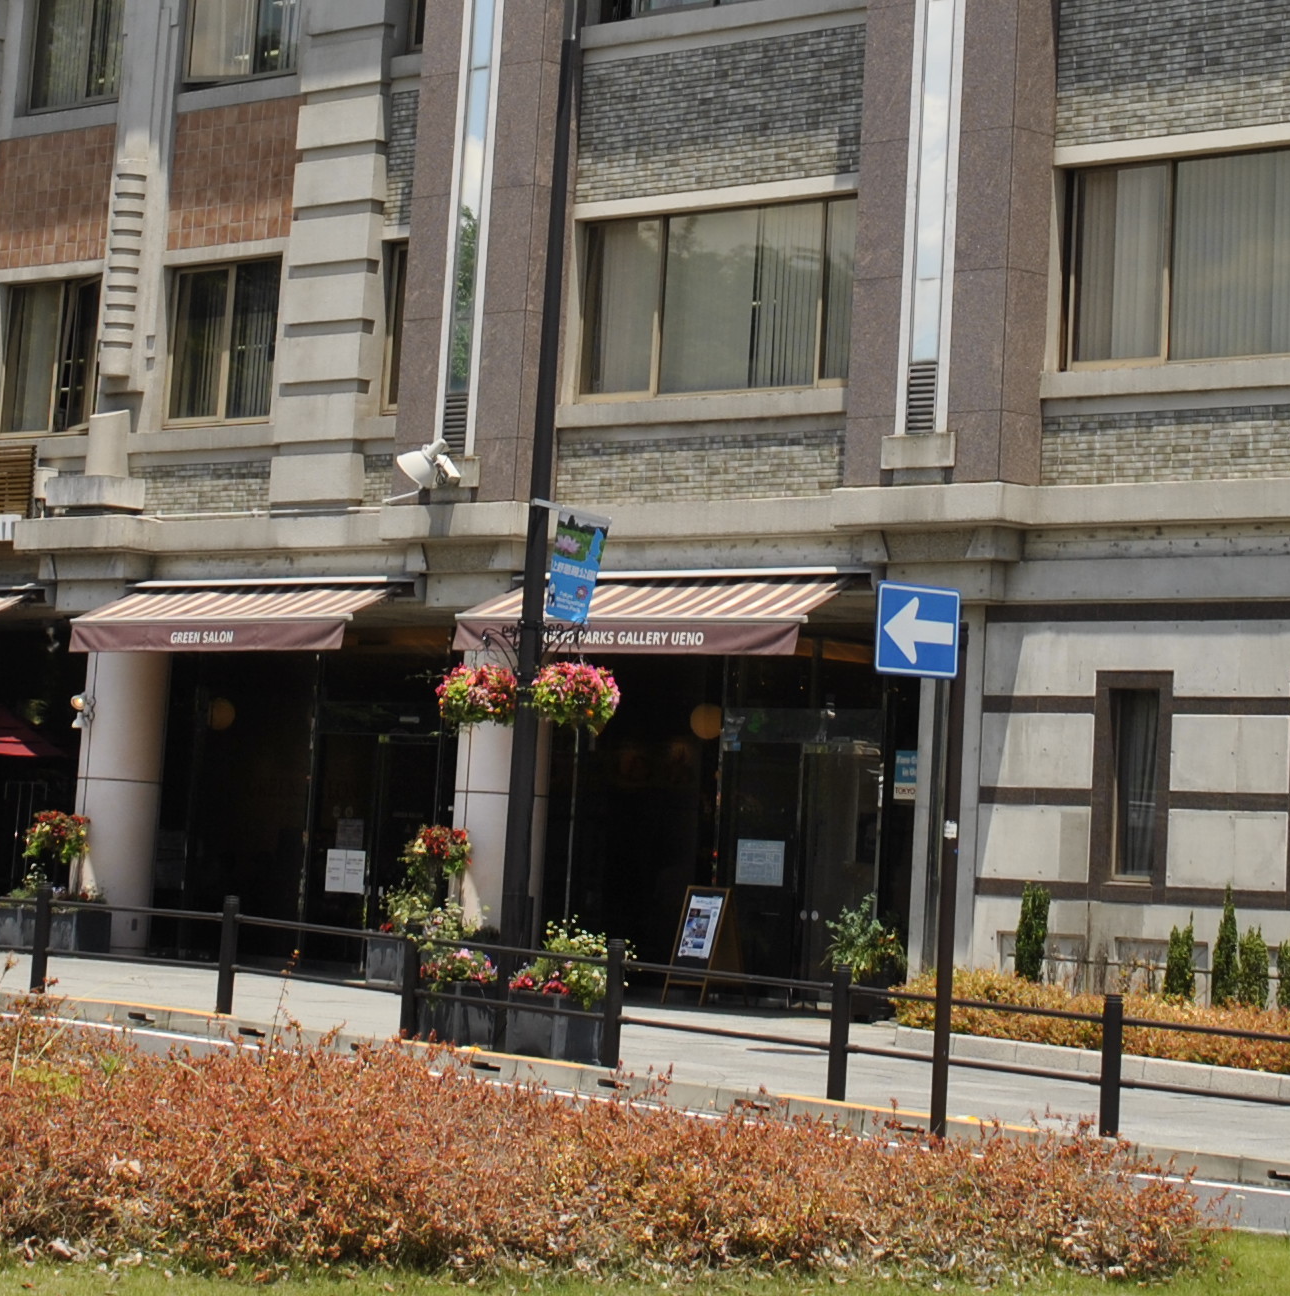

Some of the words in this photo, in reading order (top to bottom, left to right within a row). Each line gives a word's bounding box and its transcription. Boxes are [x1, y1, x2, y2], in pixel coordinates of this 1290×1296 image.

[170, 631, 200, 644] GREEN
[202, 630, 234, 644] SALON
[578, 630, 614, 645] PARKS
[617, 631, 668, 645] GALLERY
[671, 631, 705, 646] UENO
